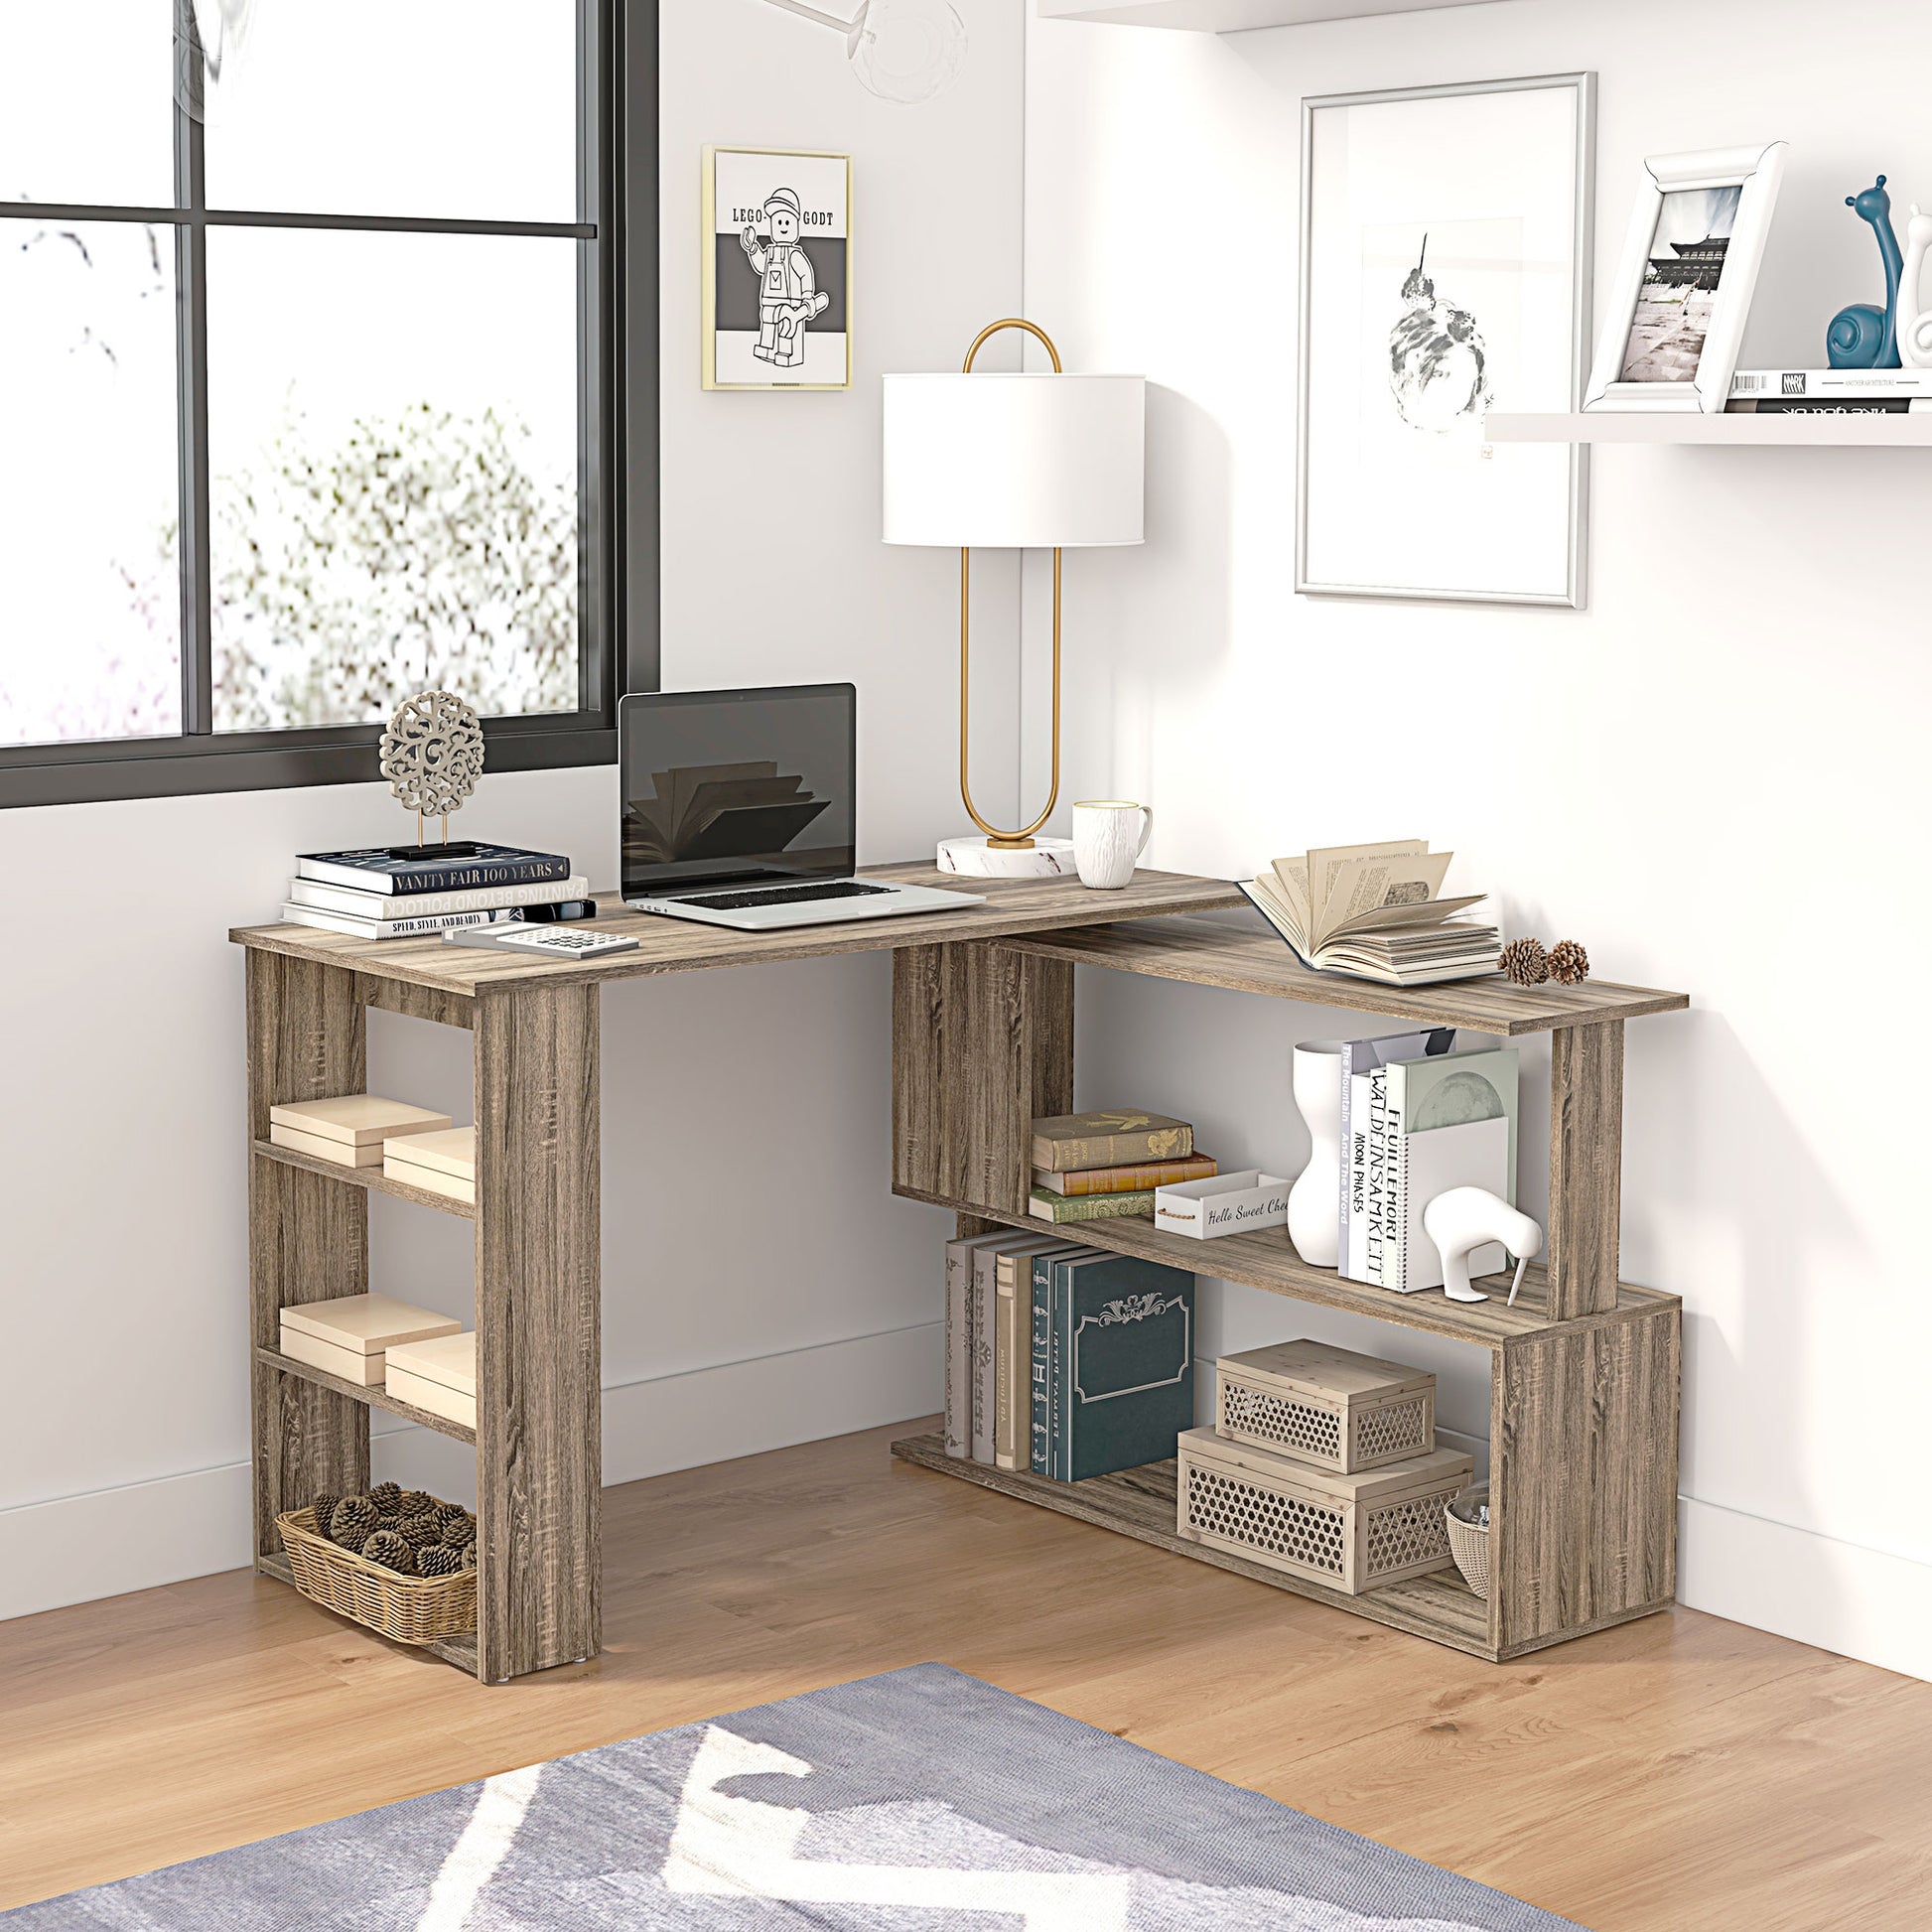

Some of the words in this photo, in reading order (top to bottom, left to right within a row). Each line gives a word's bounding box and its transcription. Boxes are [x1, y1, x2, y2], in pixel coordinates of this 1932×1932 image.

[803, 211, 833, 225] GODT
[396, 872, 447, 891] VANITY
[450, 869, 481, 886] FAIR
[511, 862, 552, 879] YEARS
[456, 890, 514, 911] BEYOND
[518, 884, 585, 903] PAINTING
[386, 897, 451, 916] POLLOCK
[455, 914, 482, 925] BEAUTY
[1341, 1043, 1351, 1066] The
[1341, 1070, 1351, 1123] Mountain
[1340, 1133, 1350, 1159] And
[1354, 1132, 1365, 1166] MOON
[1340, 1162, 1349, 1186] The
[1386, 1109, 1400, 1245] FEUILLEMORT
[1353, 1171, 1365, 1213] PHASES
[1208, 1207, 1232, 1225] Hello
[1235, 1203, 1265, 1220] Sweet
[1339, 1189, 1349, 1225] Word
